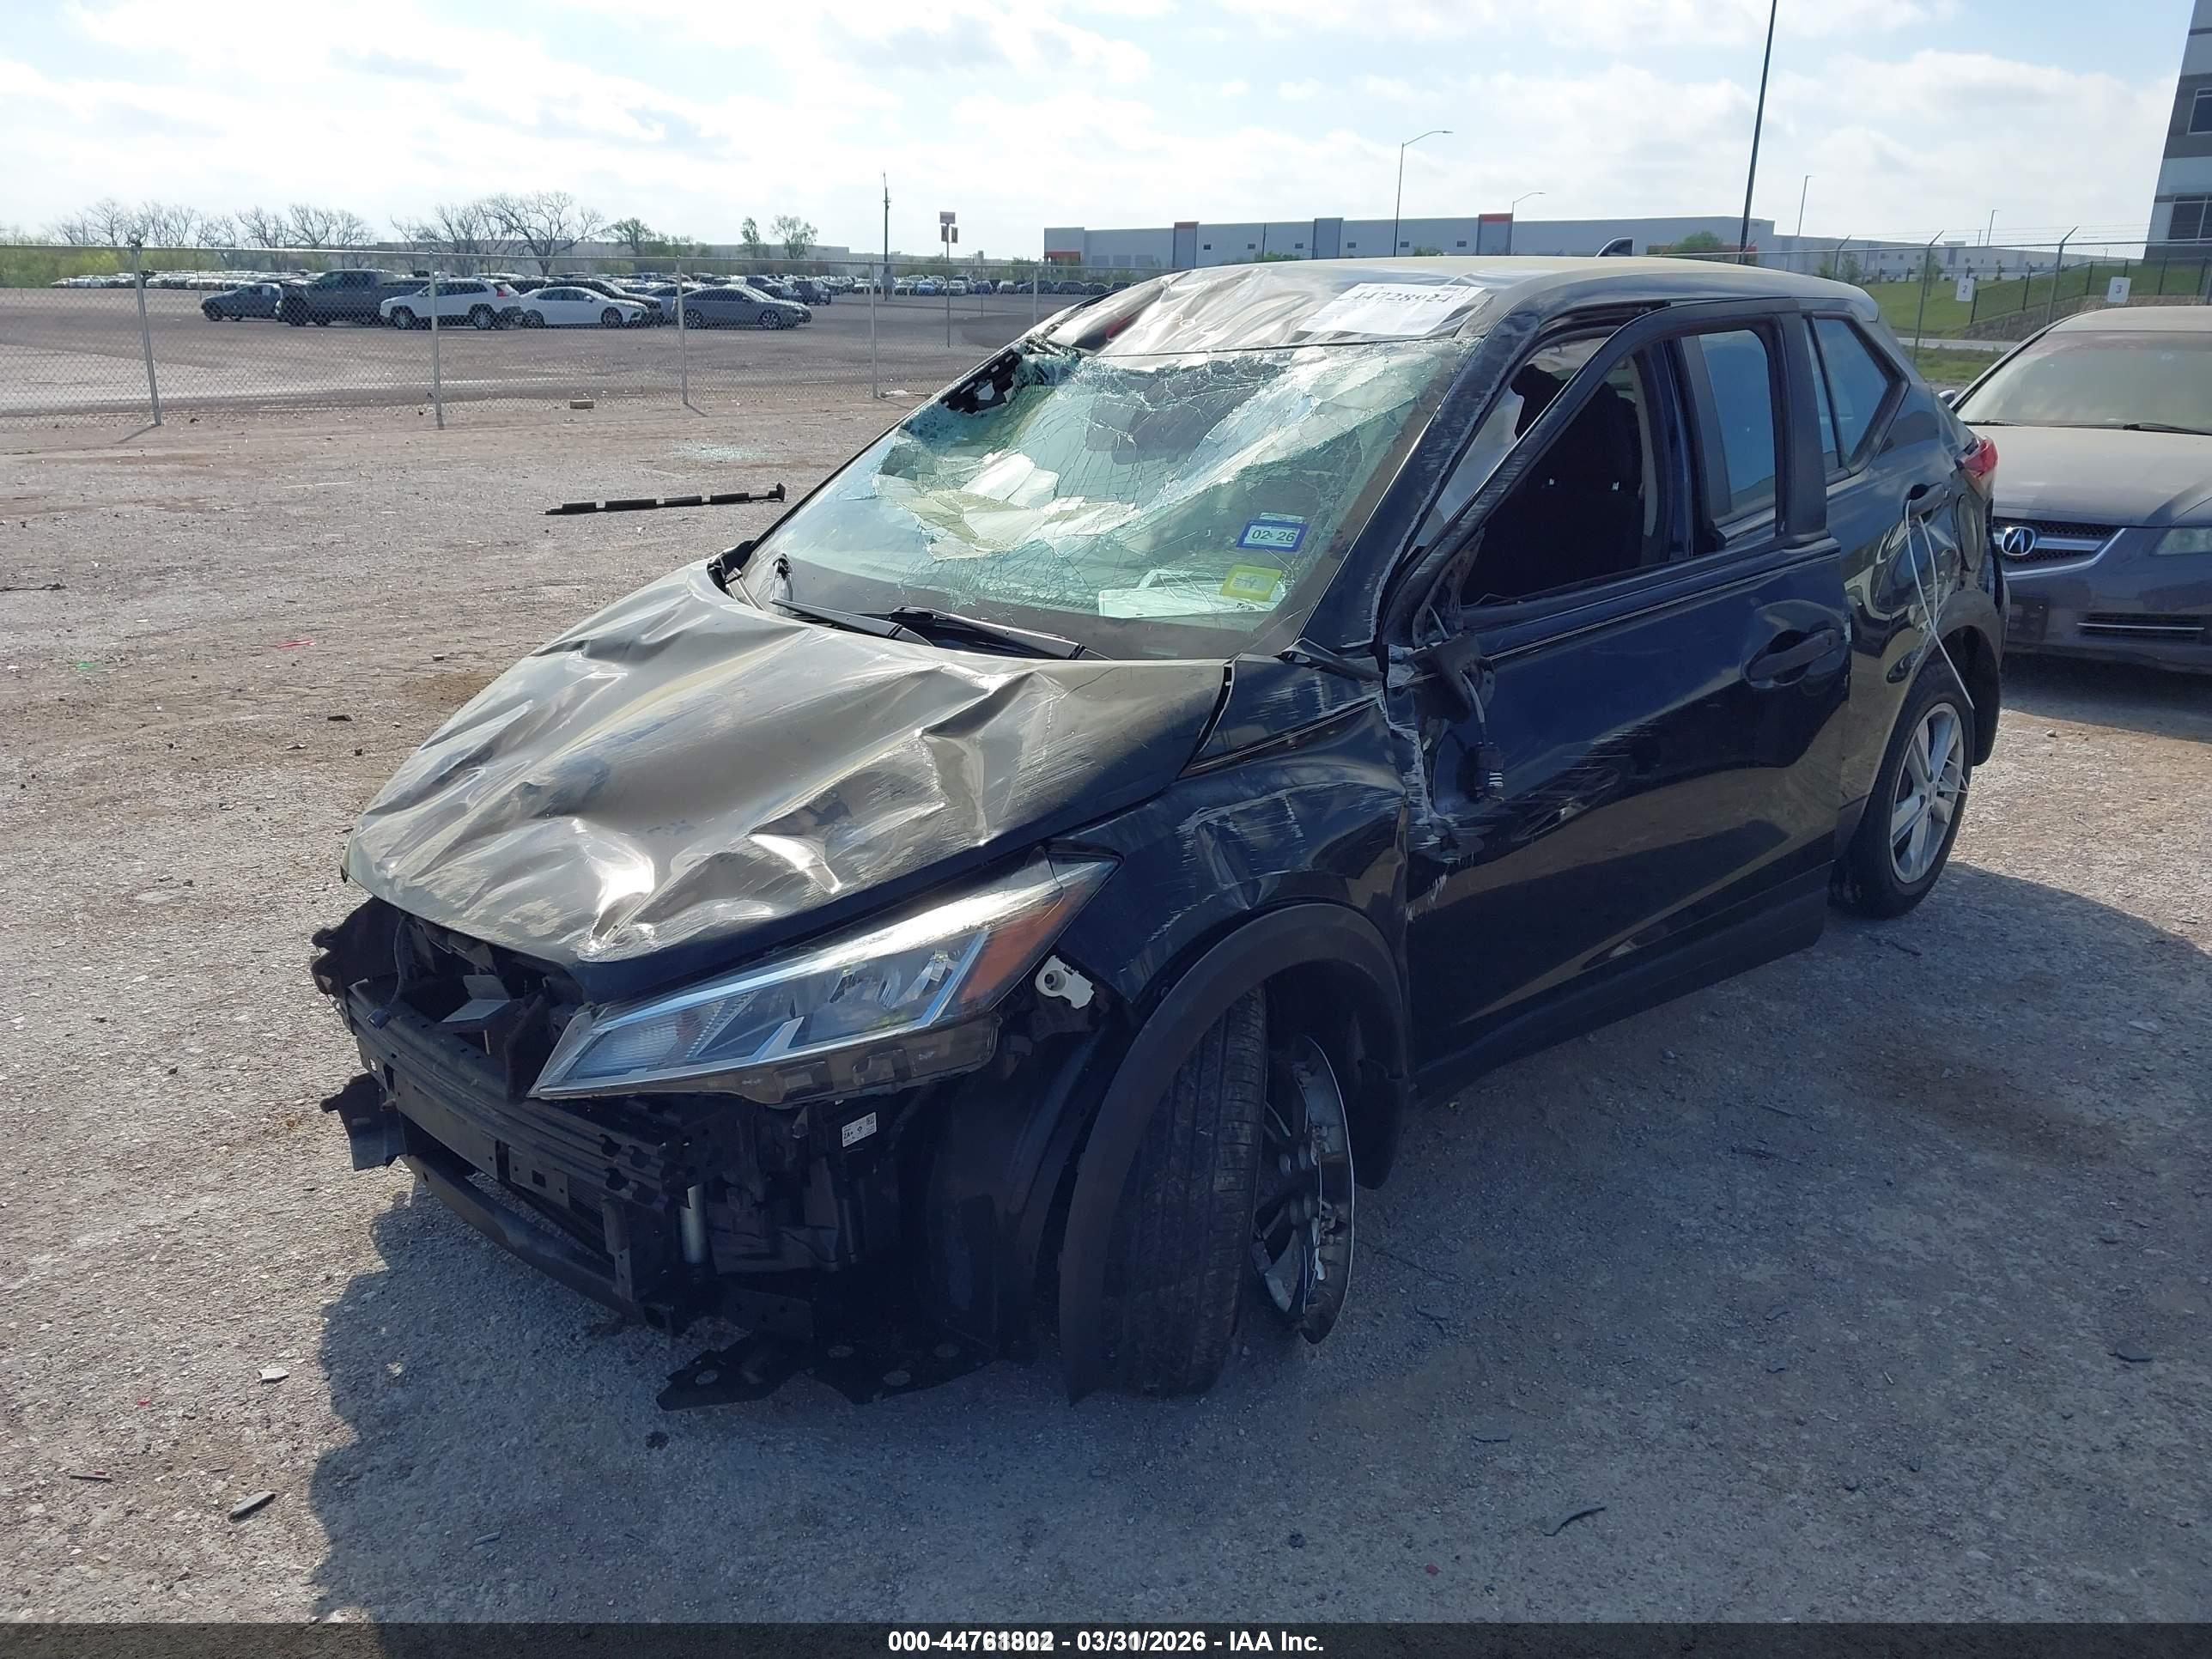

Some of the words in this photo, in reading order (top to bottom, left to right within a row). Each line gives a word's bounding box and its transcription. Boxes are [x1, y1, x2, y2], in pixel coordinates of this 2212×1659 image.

[2116, 284, 2123, 294] 3
[1252, 529, 1270, 540] 02
[1277, 531, 1297, 542] 26
